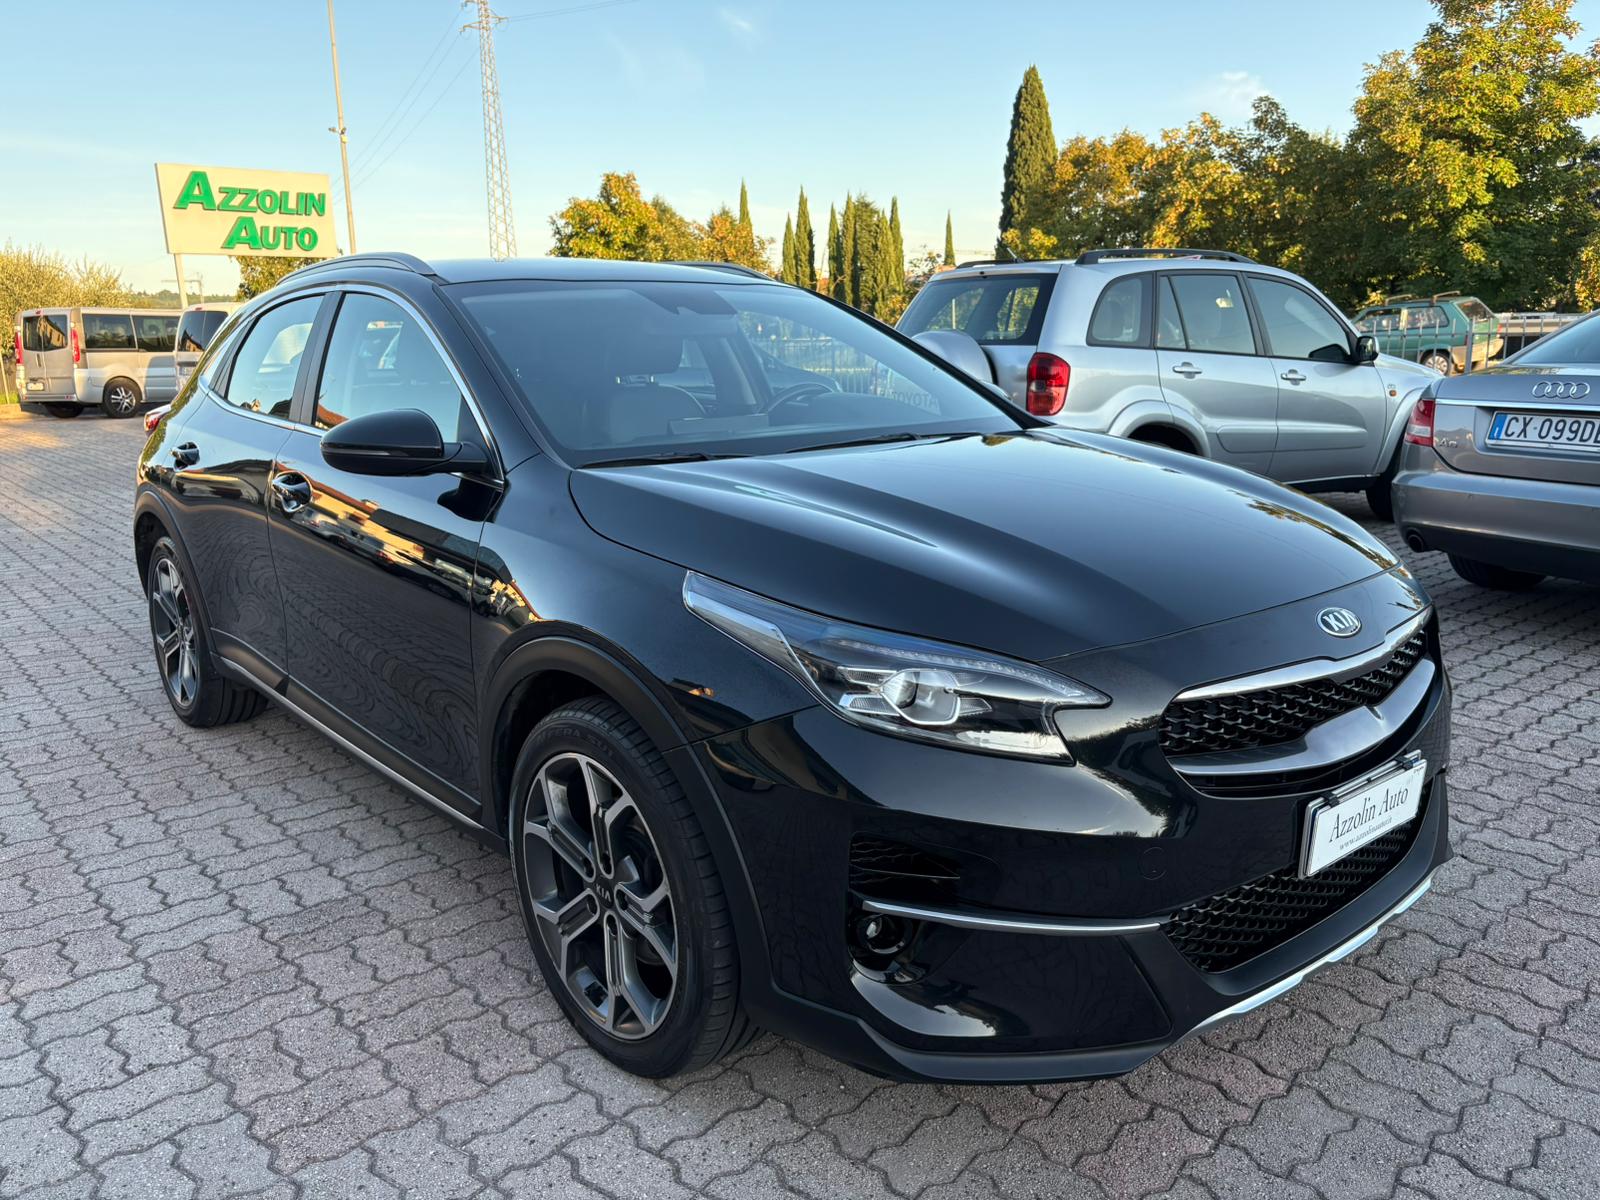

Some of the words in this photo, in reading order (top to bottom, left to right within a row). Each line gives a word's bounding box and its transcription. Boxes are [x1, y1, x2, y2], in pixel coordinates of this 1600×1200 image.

[173, 171, 326, 216] AZZOLIN
[221, 216, 318, 251] AUTO
[1322, 610, 1359, 631] KIA
[1329, 797, 1376, 843] Azzolin
[1378, 788, 1409, 817] Auto
[596, 883, 611, 902] KIA
